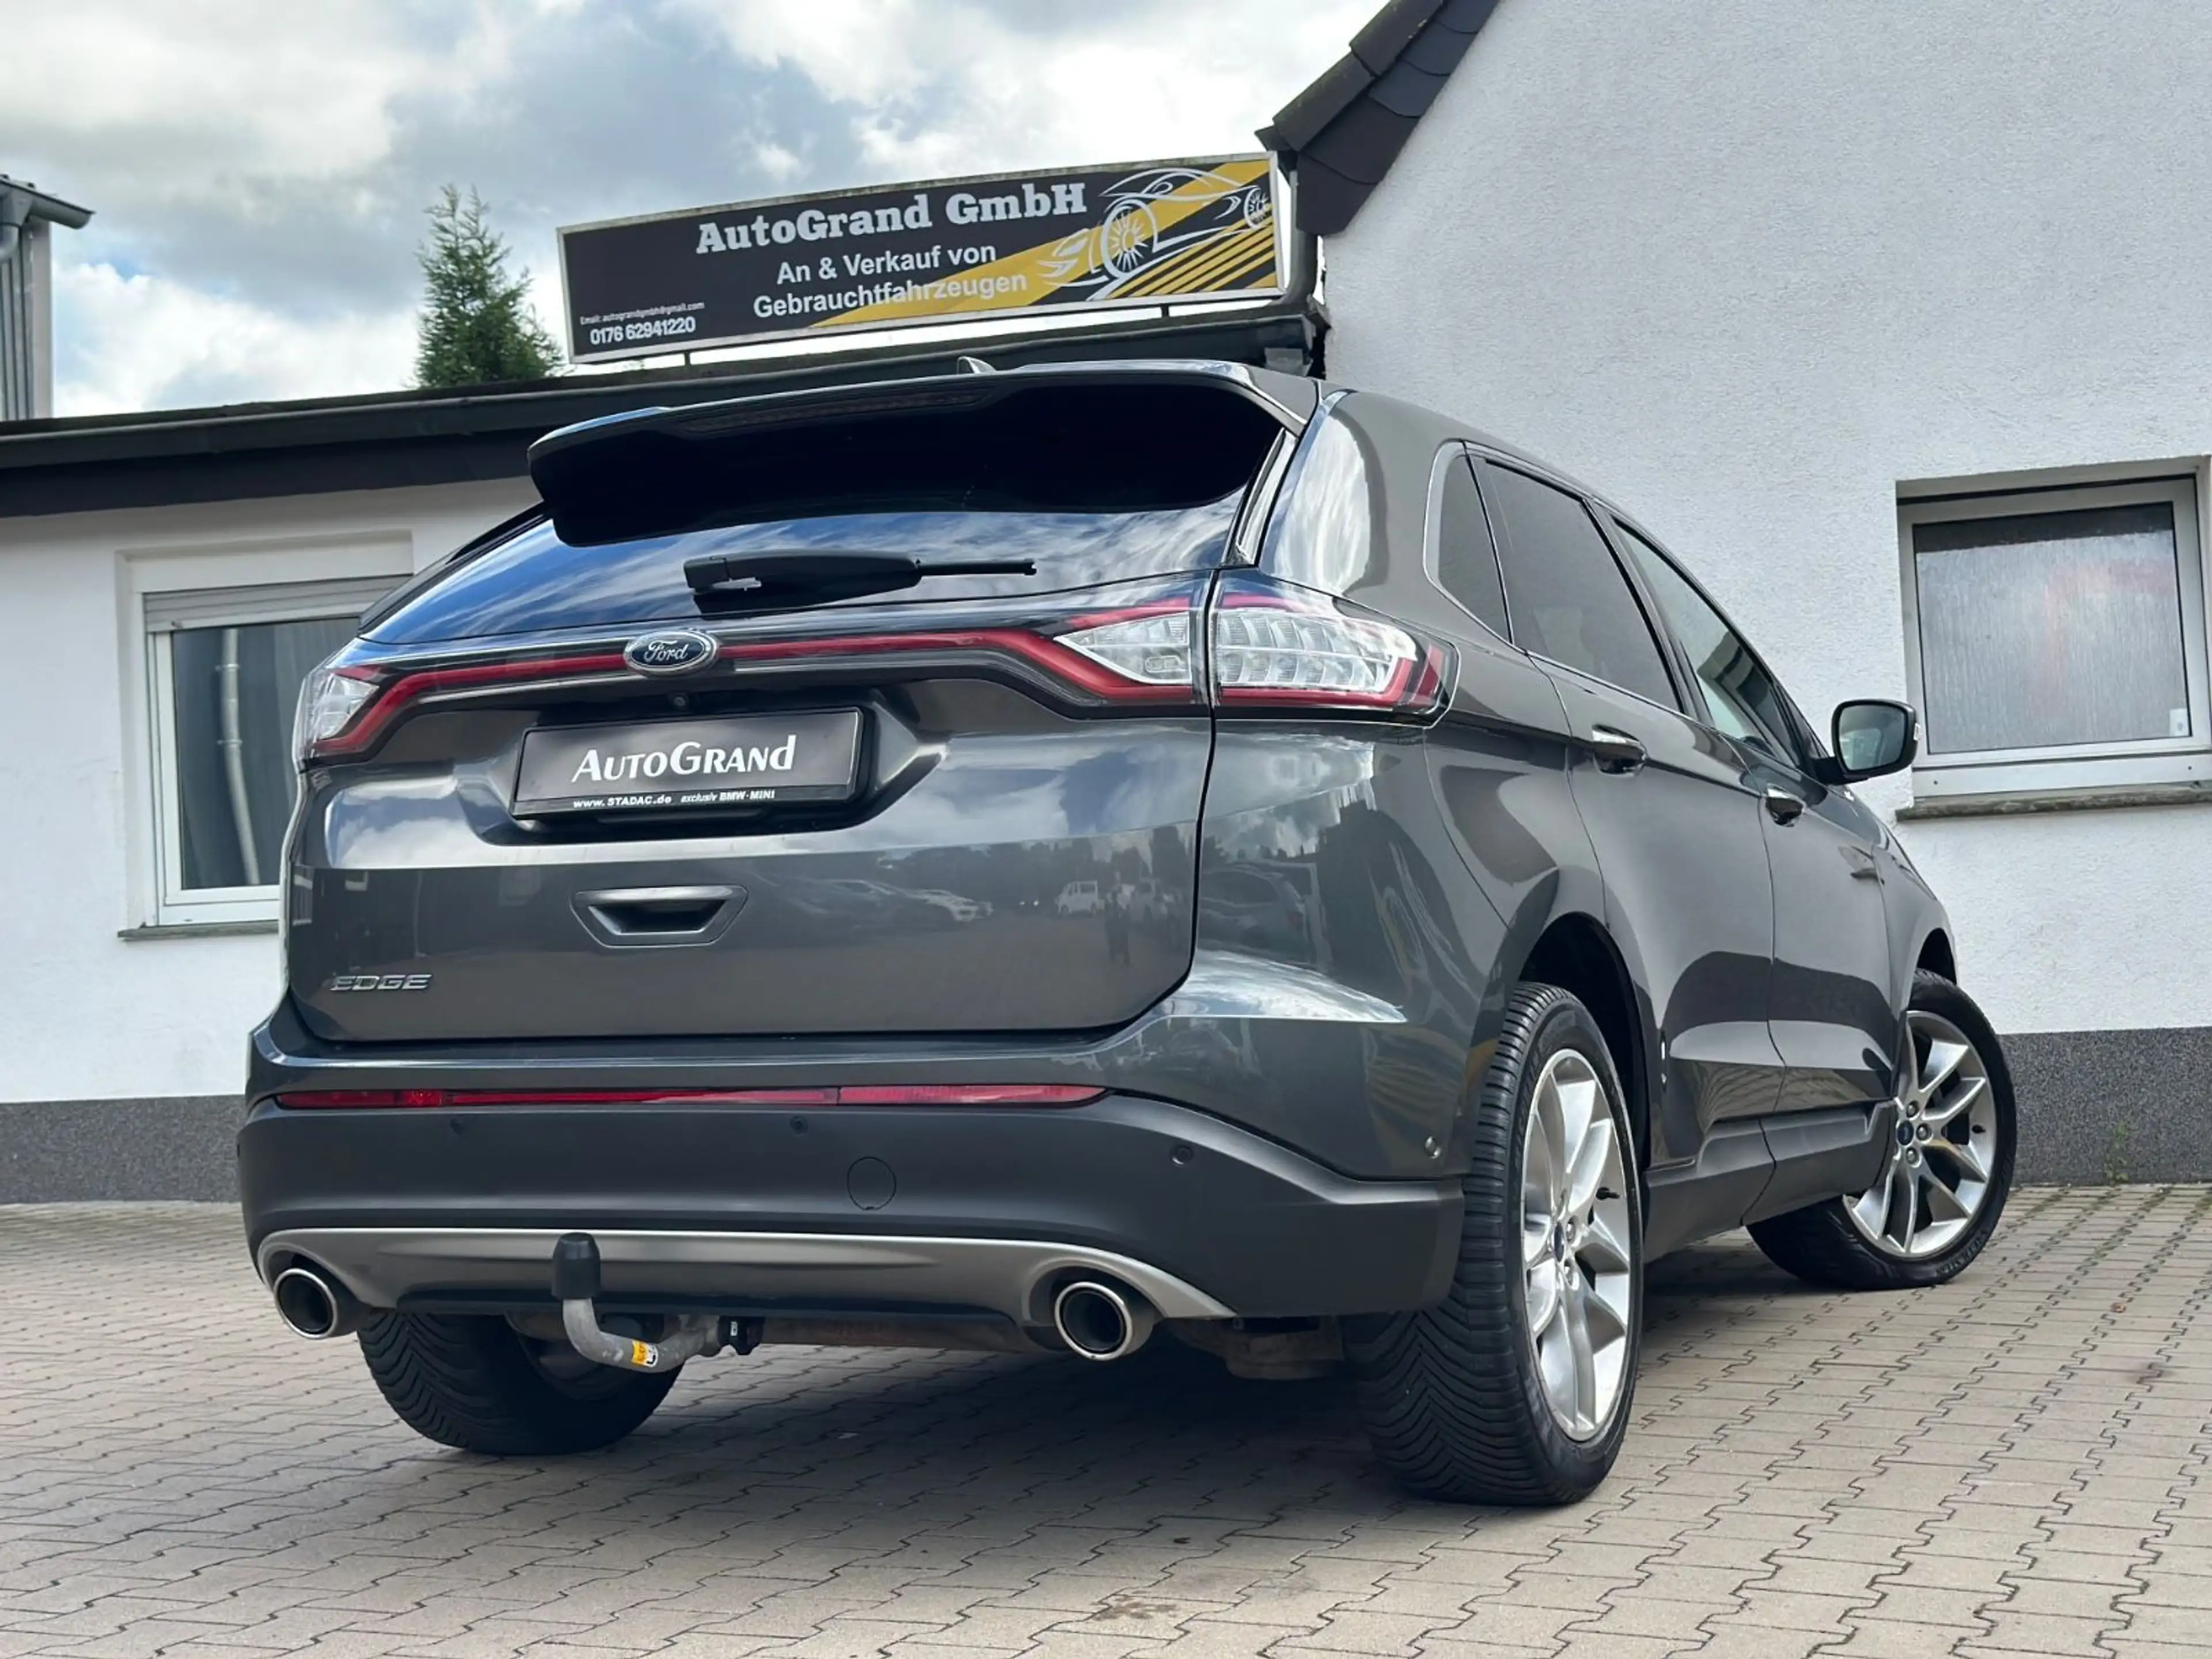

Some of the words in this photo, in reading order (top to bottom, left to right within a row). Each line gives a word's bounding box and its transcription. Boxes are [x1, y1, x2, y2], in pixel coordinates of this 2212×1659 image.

[696, 194, 932, 253] AutoGrand
[945, 183, 1086, 224] GmbH
[777, 262, 811, 284] An
[818, 256, 837, 279] &
[842, 246, 941, 276] Verkauf
[947, 244, 996, 265] von
[753, 272, 1027, 318] Gebrauchtfahrzeugen
[590, 325, 624, 344] 0176
[625, 316, 696, 339] 62941220
[643, 640, 687, 661] Ford
[680, 792, 717, 803] exclusiv
[330, 974, 432, 991] EDGE
